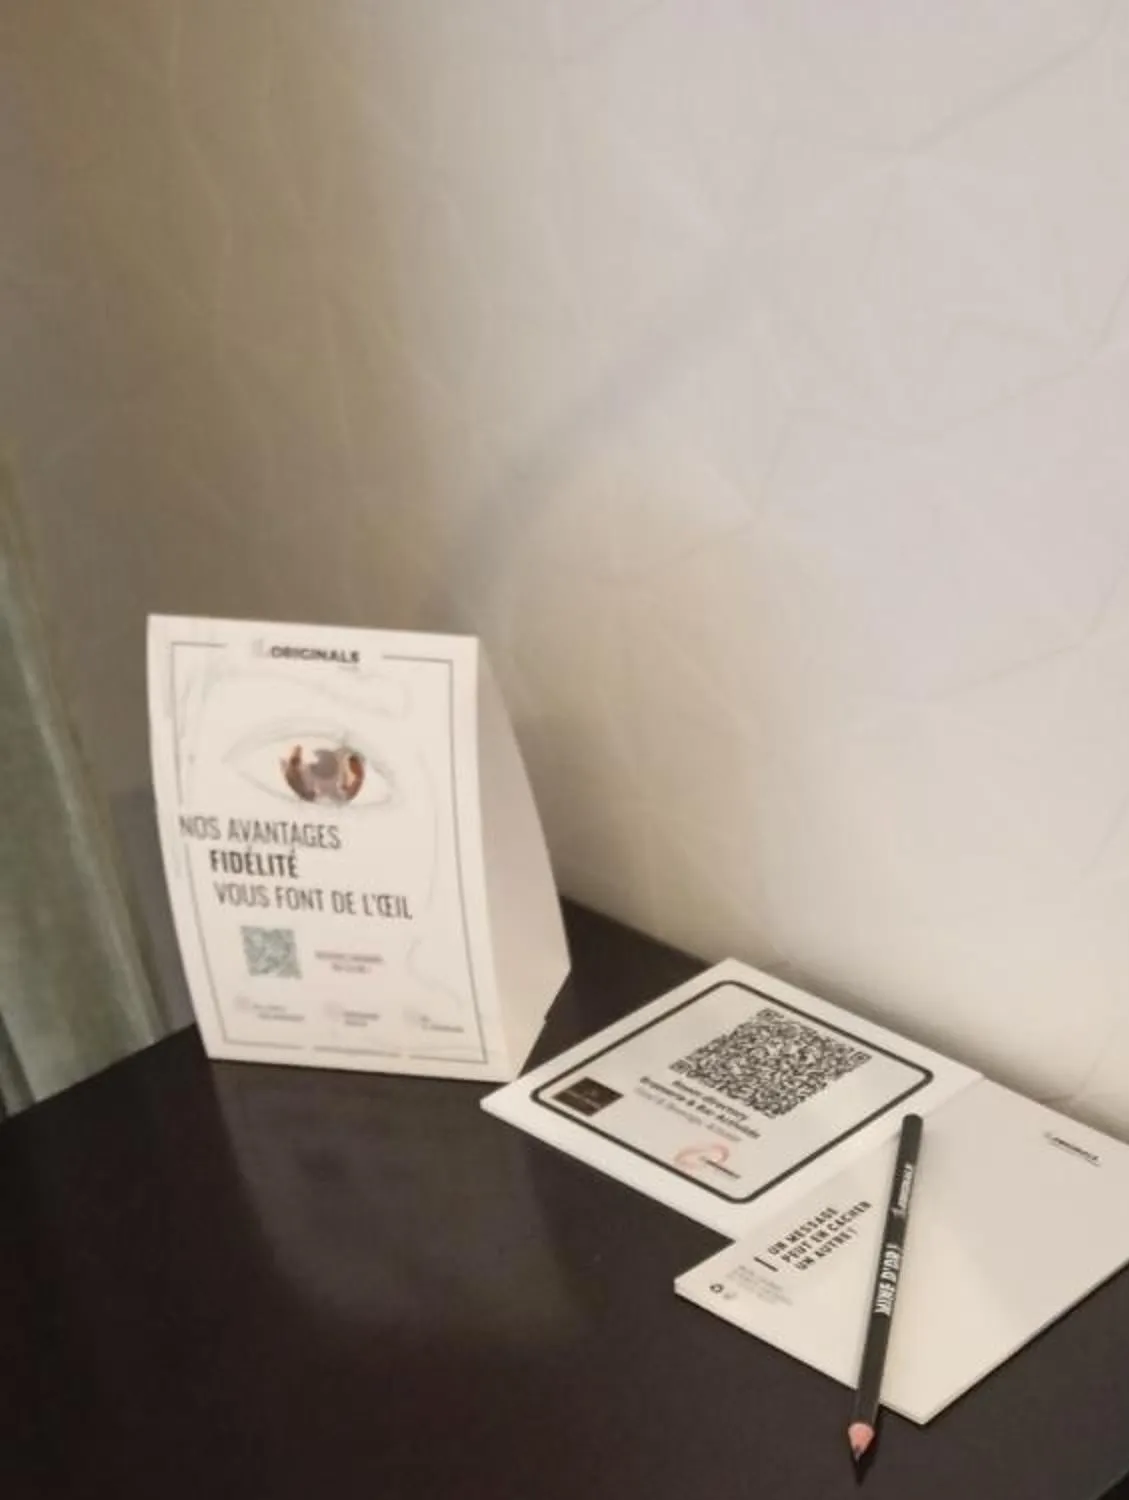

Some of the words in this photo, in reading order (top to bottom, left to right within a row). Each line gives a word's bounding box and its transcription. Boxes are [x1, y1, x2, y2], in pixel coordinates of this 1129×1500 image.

[179, 815, 221, 840] NOS
[227, 817, 342, 849] AVANTAGES
[209, 846, 300, 879] FIDÉLITÉ
[213, 881, 271, 908] VOUS
[275, 885, 325, 911] FONT
[331, 890, 357, 915] DE
[767, 1240, 788, 1255] UN
[785, 1207, 839, 1243] MESSAGE
